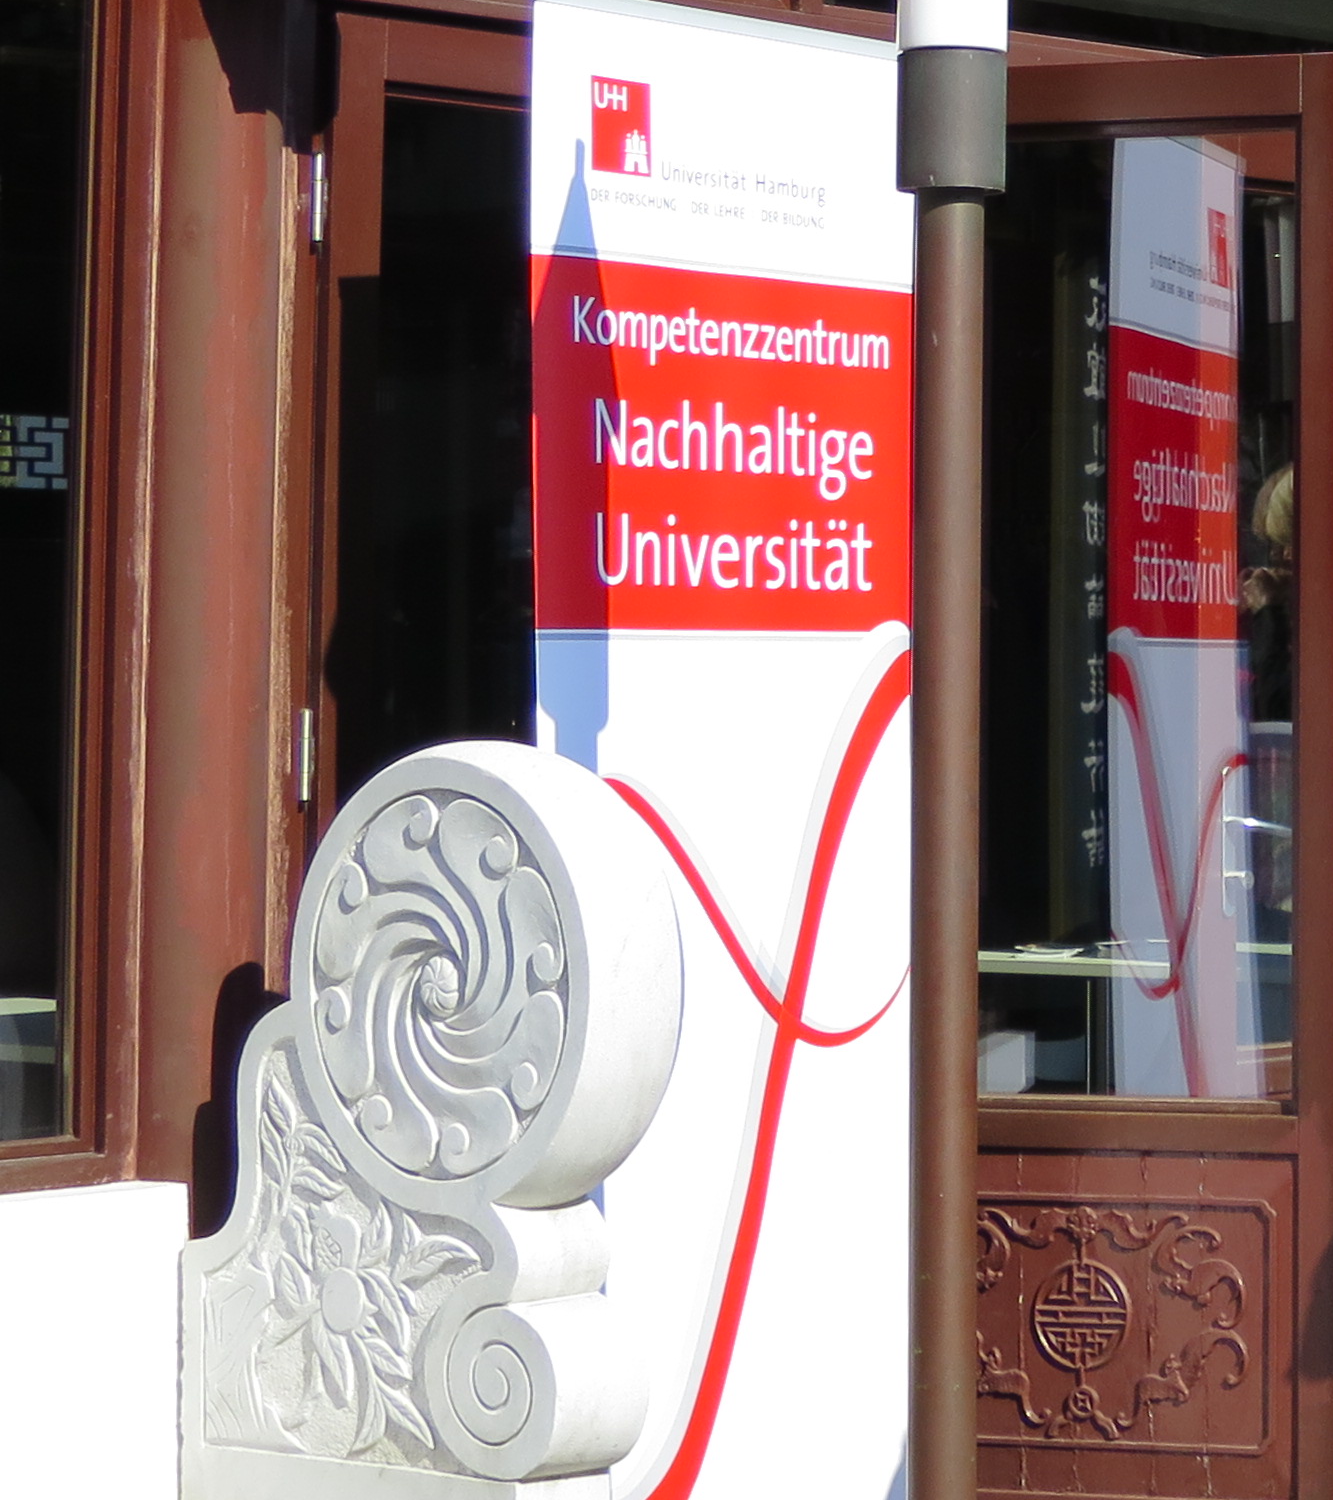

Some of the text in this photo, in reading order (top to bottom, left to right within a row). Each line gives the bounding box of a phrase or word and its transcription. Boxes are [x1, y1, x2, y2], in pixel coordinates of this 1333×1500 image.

[590, 188, 825, 229] DER FORSCHUNG DER LEHRE DER BILDUNG
[661, 161, 826, 207] Universität Hamburg
[572, 295, 890, 370] Kompetenzzentrum
[594, 398, 874, 501] Nachhaltige
[595, 512, 873, 591] Universität
